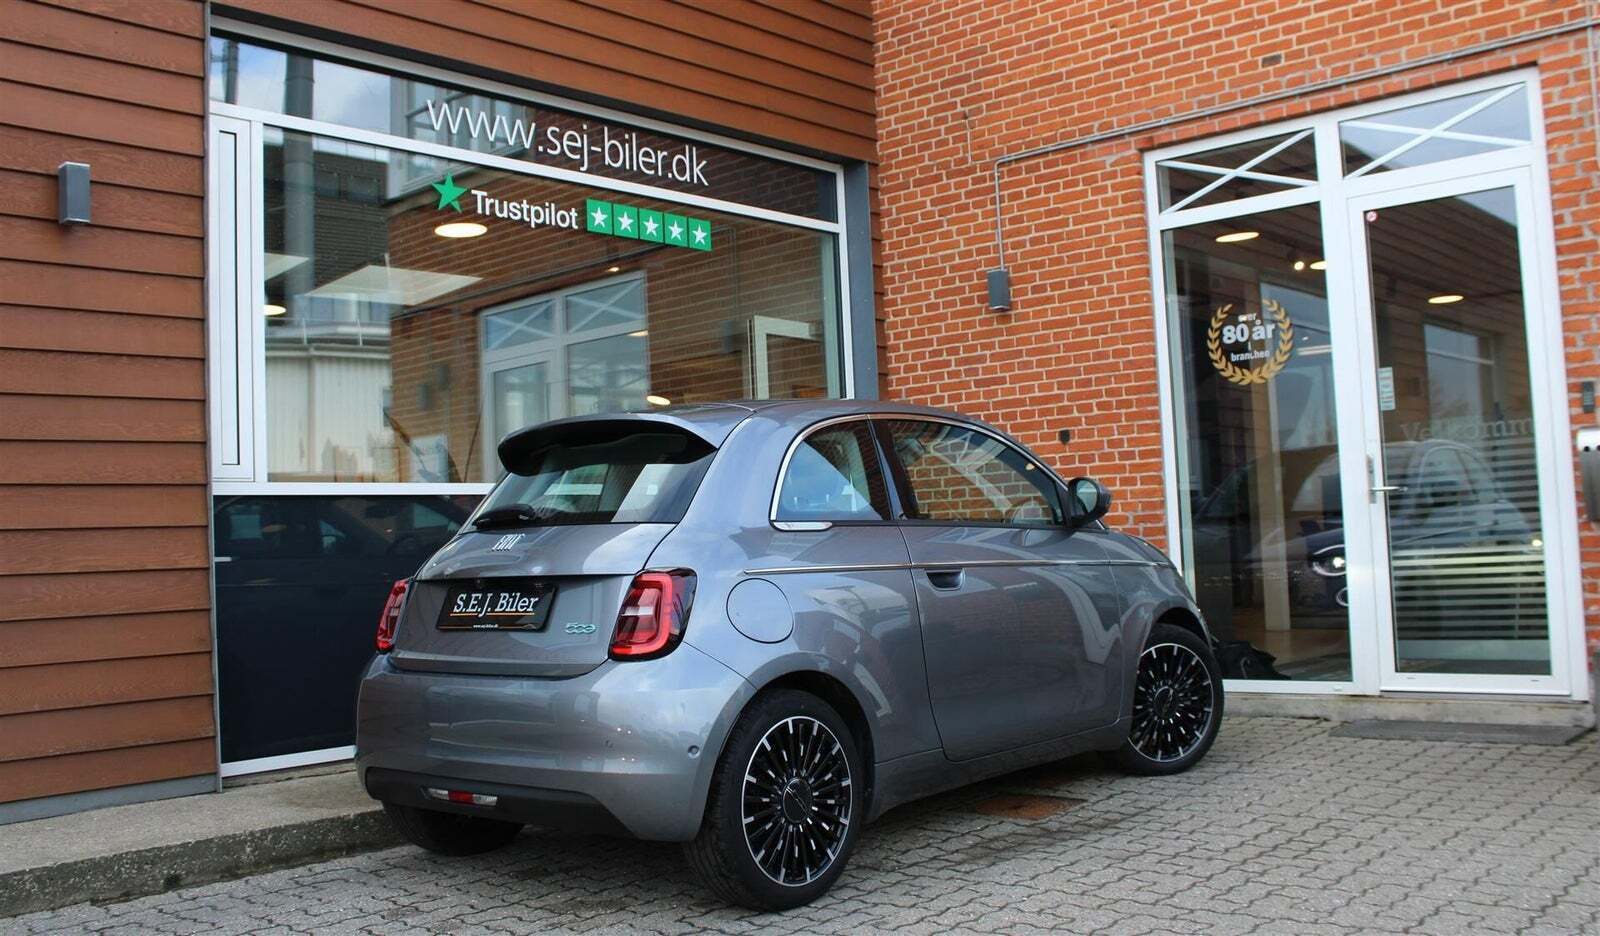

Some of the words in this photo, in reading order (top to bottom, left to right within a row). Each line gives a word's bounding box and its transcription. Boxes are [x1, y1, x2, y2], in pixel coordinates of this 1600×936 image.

[426, 100, 709, 186] www.sej-biler.dk
[471, 190, 578, 229] Trustpilot
[1222, 323, 1249, 345] 80
[1252, 320, 1275, 340] år
[1231, 350, 1270, 362] branchen
[453, 593, 491, 617] S.E.J.
[495, 592, 539, 612] Biler
[565, 622, 596, 634] 500
